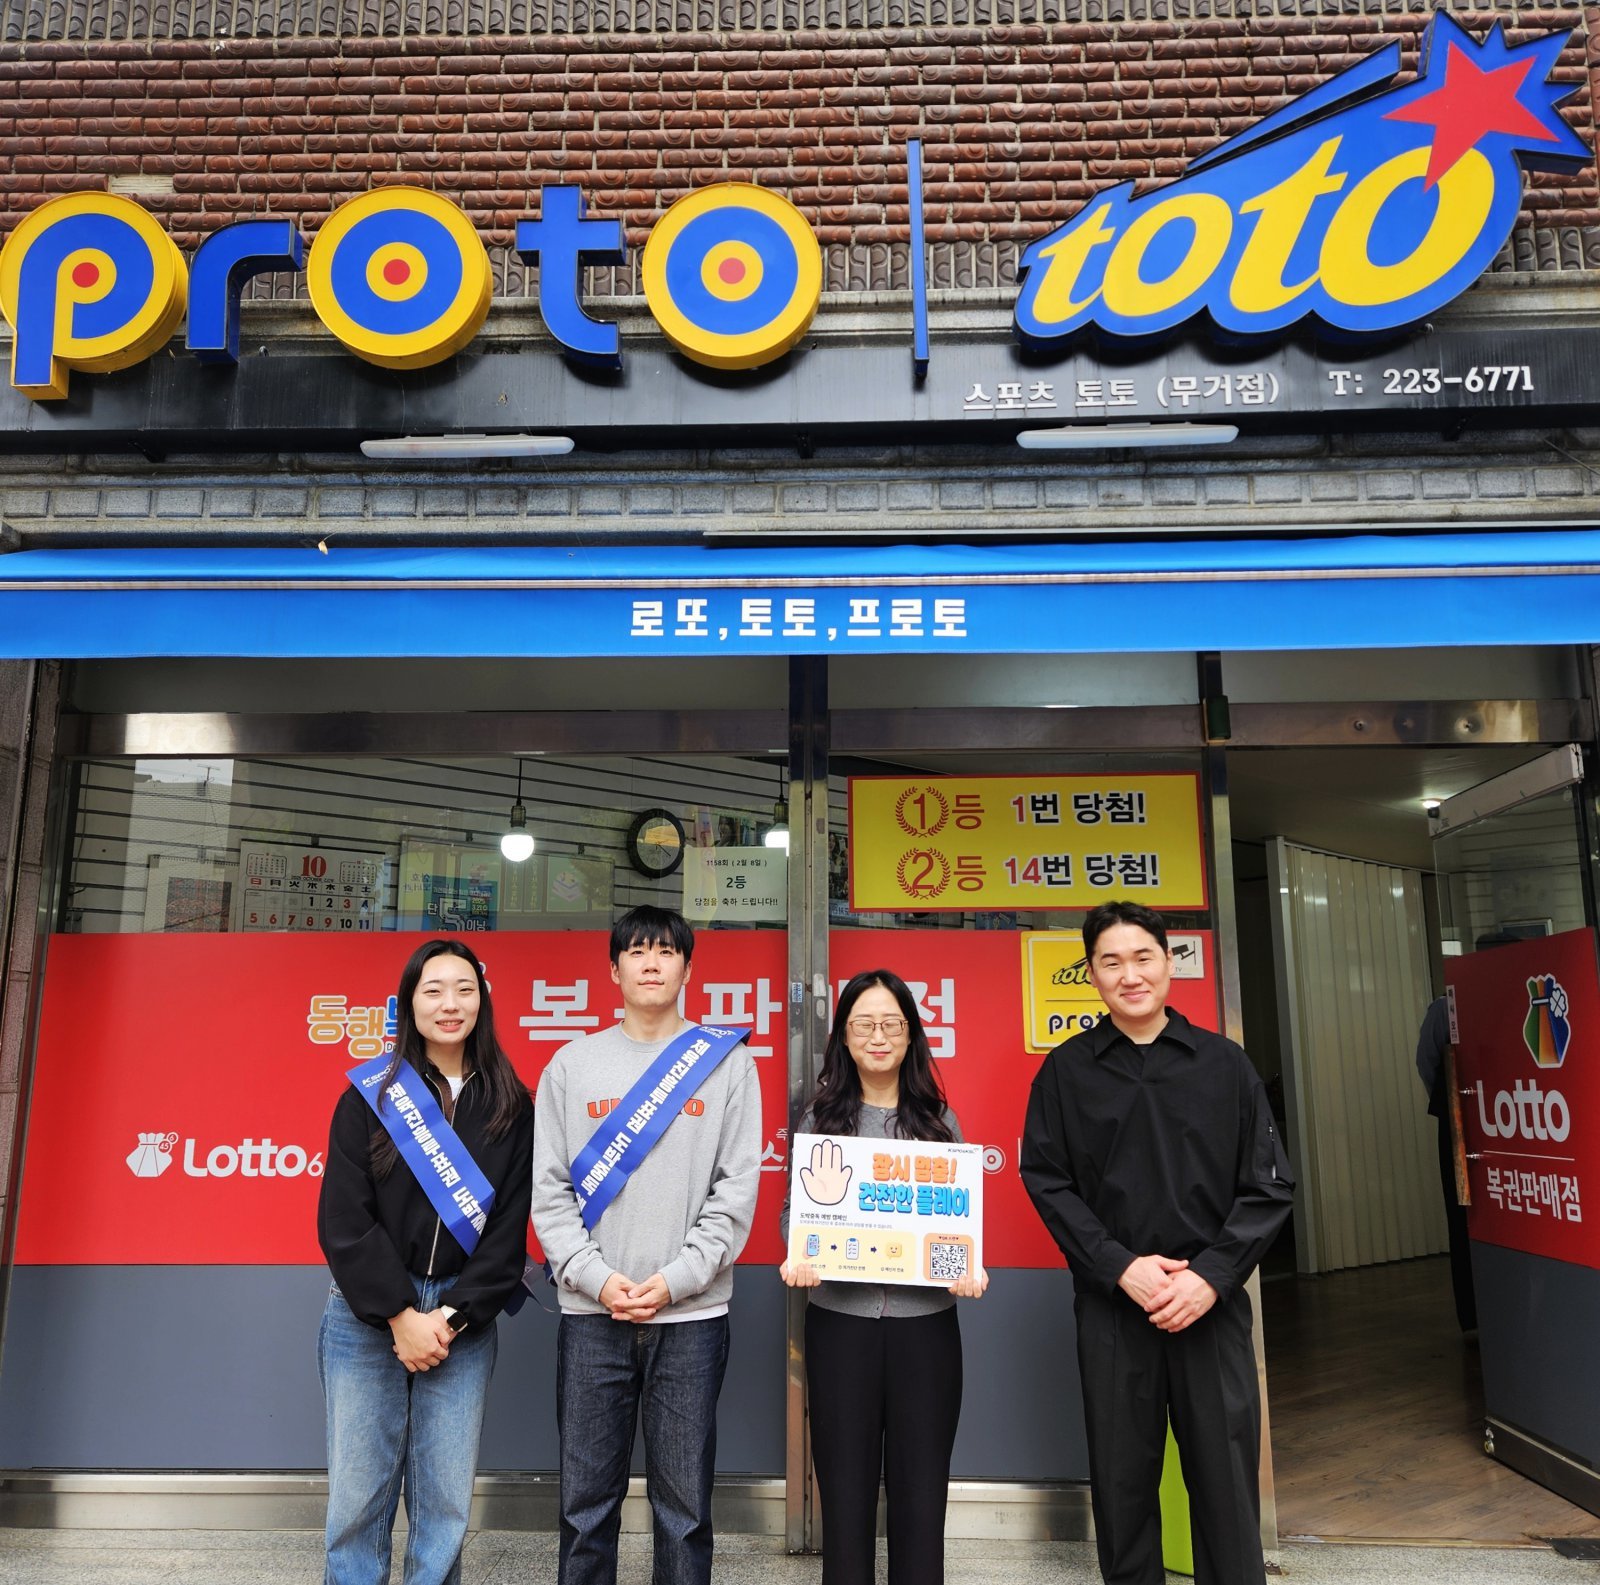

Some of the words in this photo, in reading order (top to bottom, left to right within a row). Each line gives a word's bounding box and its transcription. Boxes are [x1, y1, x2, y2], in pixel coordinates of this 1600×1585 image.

[1032, 134, 1495, 324] toto
[0, 183, 822, 400] proto
[963, 381, 1058, 411] 스포츠
[1075, 379, 1139, 408] 토토
[1156, 371, 1281, 407] (무거점)
[1328, 370, 1365, 397] T:
[1383, 365, 1535, 395] 223-6771
[1011, 792, 1061, 824] 1번
[1072, 791, 1146, 825] 당첨!
[300, 855, 327, 878] 10
[726, 875, 747, 889] 2등
[1003, 853, 1073, 886] 14번
[1085, 853, 1160, 886] 당첨!
[326, 898, 333, 908] 2
[343, 899, 351, 908] 3
[741, 897, 778, 906] 드립니다!!
[250, 913, 258, 923] 5
[269, 914, 278, 924] 6
[288, 915, 296, 925] 7
[306, 916, 314, 926] 8
[324, 917, 333, 927] 9
[340, 919, 352, 929] 10
[358, 919, 370, 930] 11
[518, 977, 957, 1060] 복판점
[1476, 1078, 1571, 1143] Lotto
[872, 1152, 911, 1182] 잠시
[914, 1155, 958, 1185] 멈춤!
[859, 1182, 914, 1213] 건전한
[916, 1184, 970, 1217] 플레이
[1486, 1166, 1583, 1223] 복권판매점
